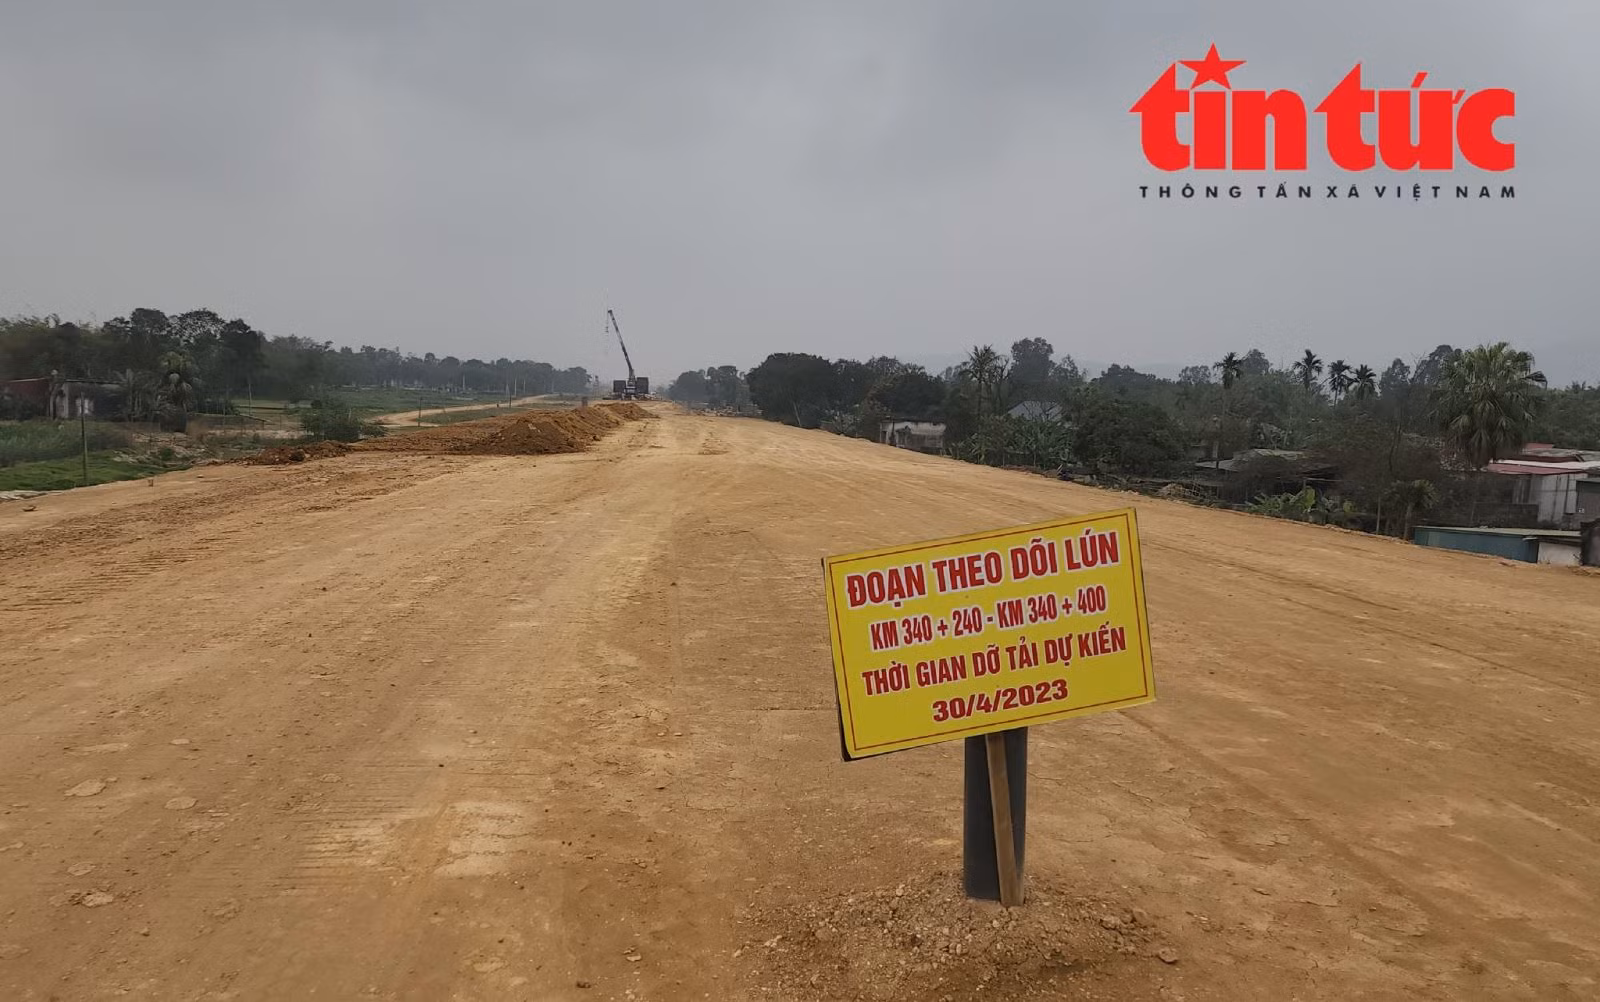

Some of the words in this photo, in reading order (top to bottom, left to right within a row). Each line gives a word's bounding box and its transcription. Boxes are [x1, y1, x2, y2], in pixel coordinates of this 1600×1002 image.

[847, 564, 926, 609] ĐOẠN
[932, 551, 1002, 593] THEO
[1010, 538, 1058, 579] DÕI
[1065, 529, 1119, 570] LÚN
[871, 620, 899, 650] KM
[903, 615, 933, 645] 340
[937, 619, 948, 634] +
[952, 607, 982, 636] 240
[997, 599, 1025, 628] KM
[1028, 594, 1058, 623] 340
[1062, 597, 1073, 614] +
[1077, 585, 1107, 614] 400
[862, 660, 911, 695] THỜI
[916, 655, 967, 687] GIAN
[1005, 636, 1039, 671] TẢI
[1044, 633, 1074, 667] DỰ
[1078, 621, 1127, 658] KIẾN
[932, 679, 1069, 722] 30/4/2023
